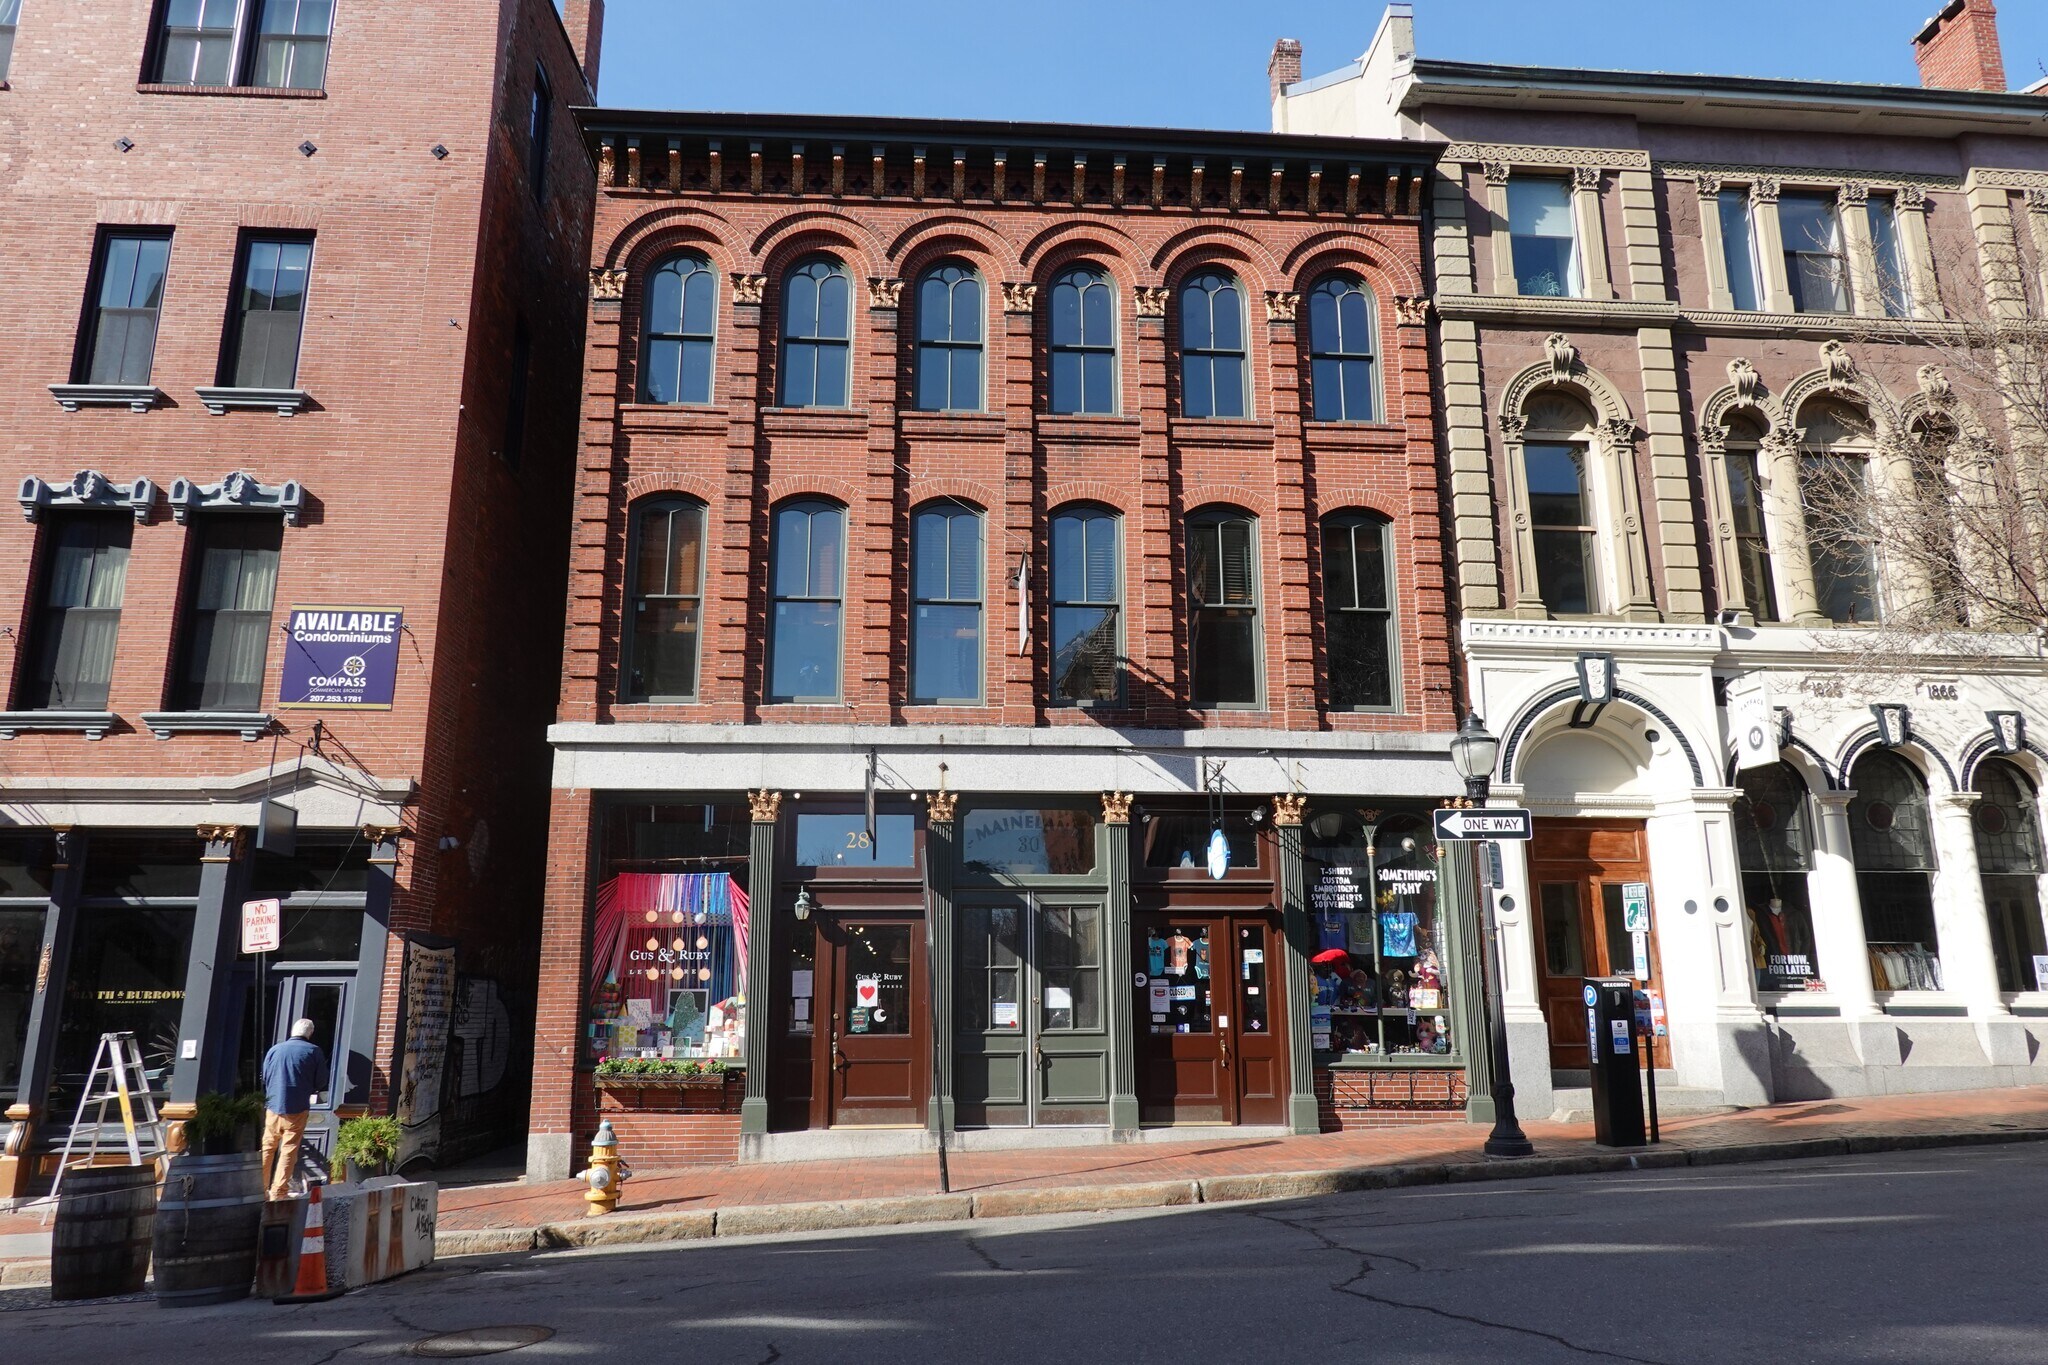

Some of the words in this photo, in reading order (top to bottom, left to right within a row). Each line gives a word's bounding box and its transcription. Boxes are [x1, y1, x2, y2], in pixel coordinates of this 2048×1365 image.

[294, 612, 397, 632] AVAILABLE
[294, 630, 392, 643] Condominiums
[309, 676, 367, 687] COMPASS
[1927, 684, 1959, 700] 1866
[1463, 819, 1489, 830] ONE
[1493, 819, 1519, 830] WAY
[846, 831, 870, 849] 28
[1018, 836, 1040, 853] 30
[1320, 867, 1353, 875] T-SHIRTS
[1377, 868, 1437, 881] SOMETHING'S
[1322, 876, 1351, 884] CUSTOM
[1314, 884, 1359, 893] EMBROIDERY
[1392, 882, 1422, 895] FISHY
[1311, 893, 1363, 902] SWEATSHIRTS
[255, 904, 267, 915] NO
[1314, 900, 1354, 909] SOUVENIRS
[245, 914, 276, 927] PARKING
[253, 932, 270, 940] TIME
[658, 948, 675, 963] &
[679, 949, 711, 960] RUBY
[1770, 955, 1787, 965] FOR
[1788, 954, 1810, 965] NOW.
[1768, 965, 1785, 975] FOR
[1786, 965, 1814, 975] LATER.
[871, 972, 882, 982] &
[117, 990, 125, 999] &
[126, 990, 186, 1000] BURROWS
[1169, 988, 1187, 997] CLOSED
[1586, 989, 1593, 1002] P
